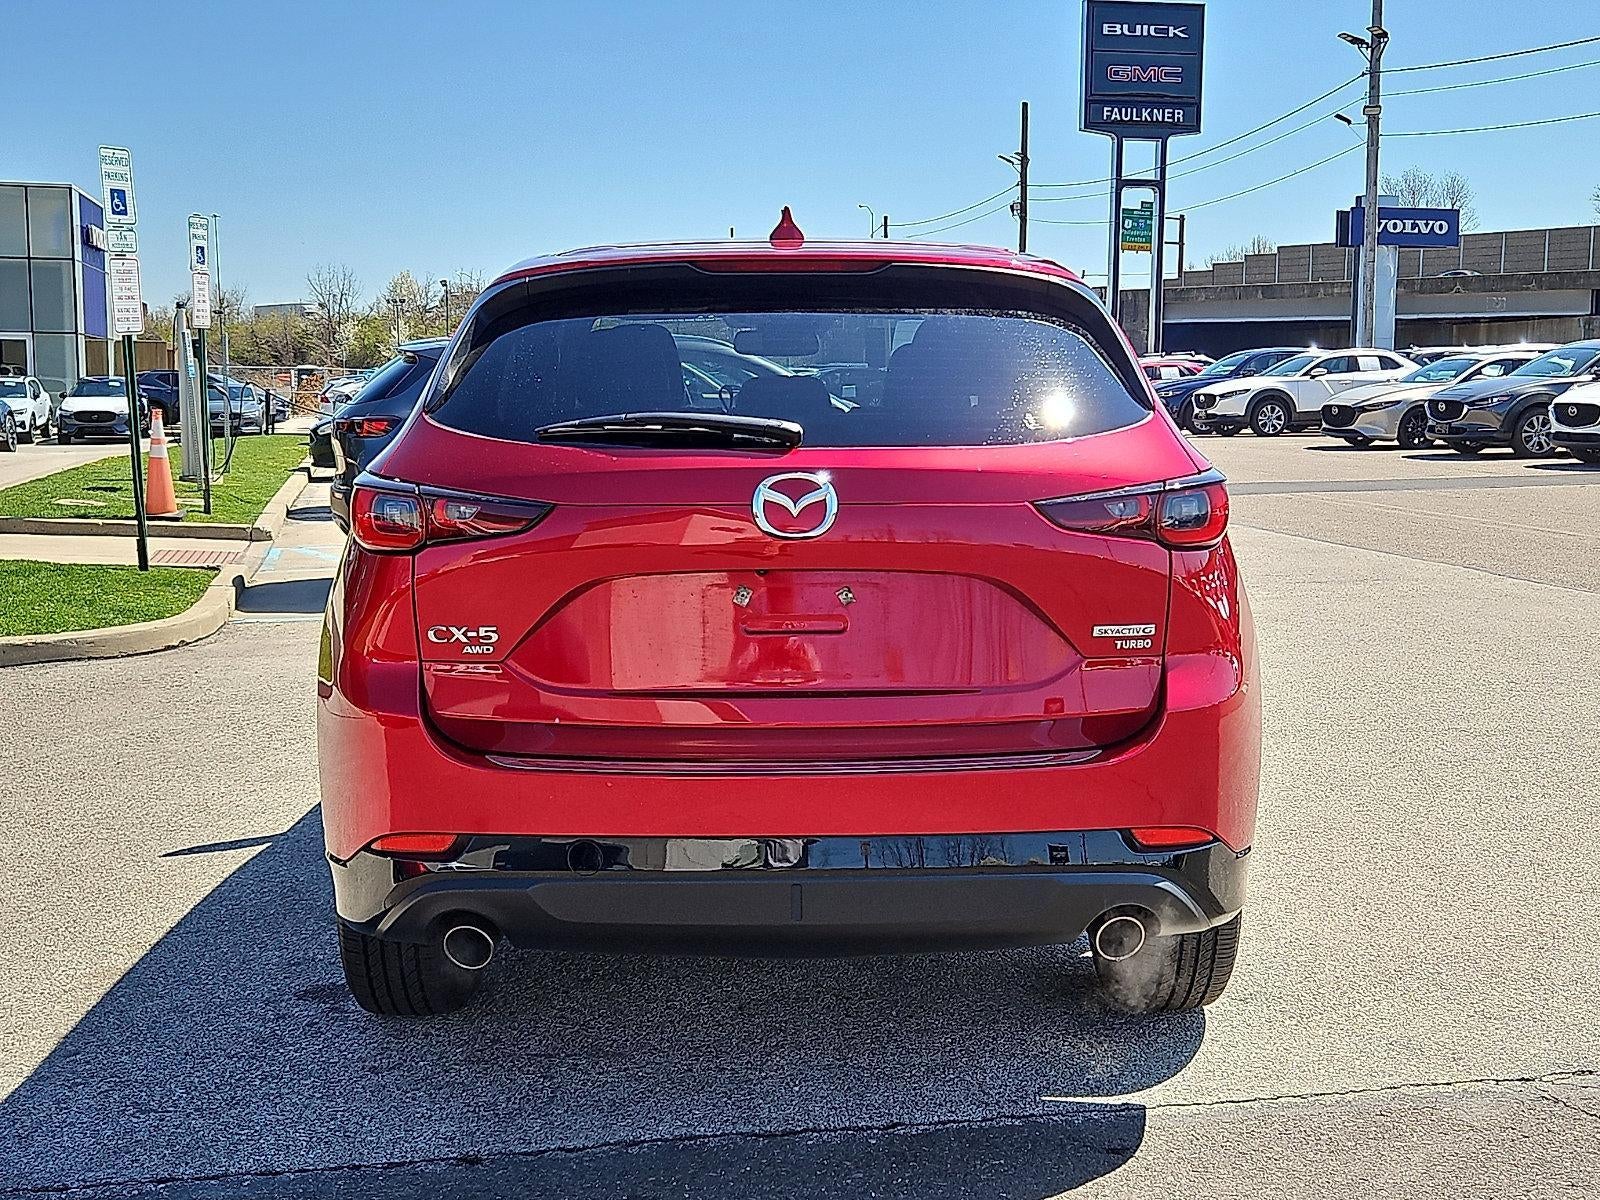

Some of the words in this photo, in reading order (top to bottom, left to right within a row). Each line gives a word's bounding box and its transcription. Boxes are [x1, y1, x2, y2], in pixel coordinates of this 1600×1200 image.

[1102, 23, 1189, 38] BUICK
[1107, 65, 1182, 82] GMC
[1103, 107, 1184, 122] FAULKNER
[101, 154, 129, 167] RESERVED
[104, 170, 128, 182] PARKING
[427, 625, 499, 643] CX-5
[461, 645, 494, 654] AWD
[1115, 639, 1152, 649] TURBO
